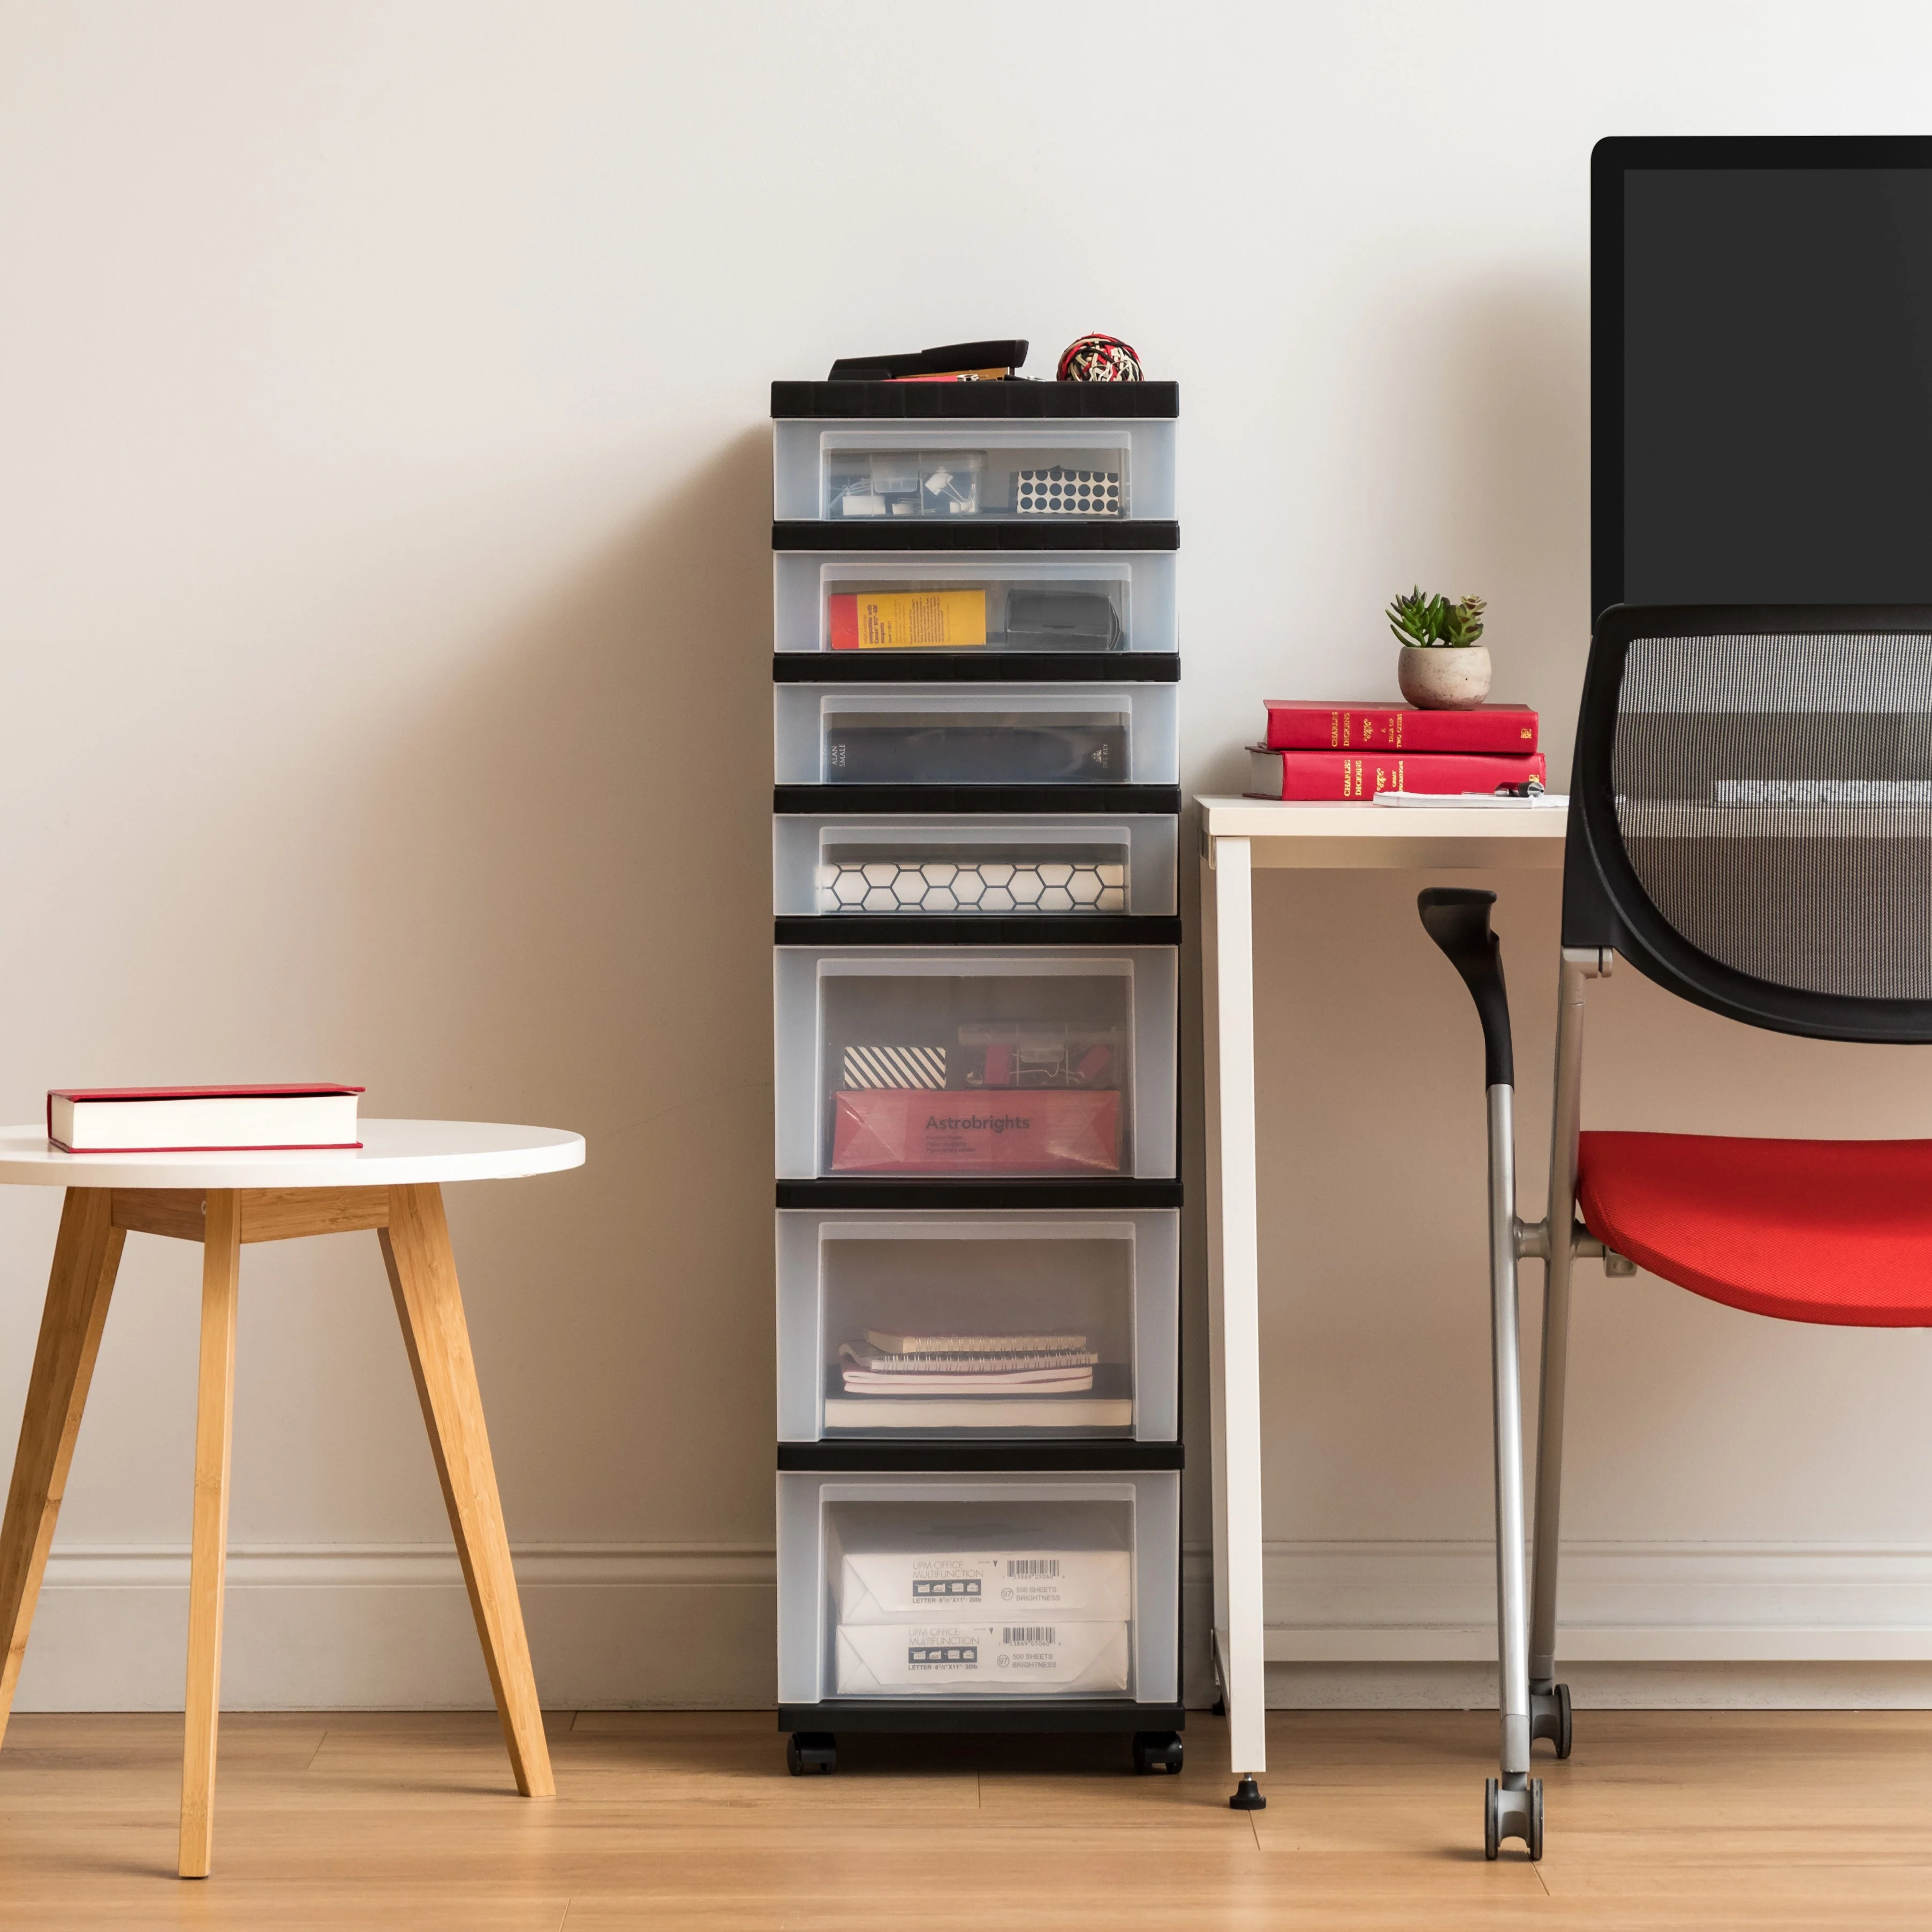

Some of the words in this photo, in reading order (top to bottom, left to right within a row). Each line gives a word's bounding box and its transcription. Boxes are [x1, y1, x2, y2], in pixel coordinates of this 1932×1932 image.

[1389, 718, 1394, 727] OF
[926, 1115, 1030, 1133] Astrobrights
[912, 1561, 932, 1570] UPM
[934, 1560, 963, 1570] OFFICE
[912, 1569, 984, 1579] MULTIFUNCTION
[908, 1628, 928, 1636] UPM
[929, 1628, 959, 1636] OFFICE
[908, 1636, 980, 1646] MULTIFUNCTION
[998, 1657, 1009, 1665] 97
